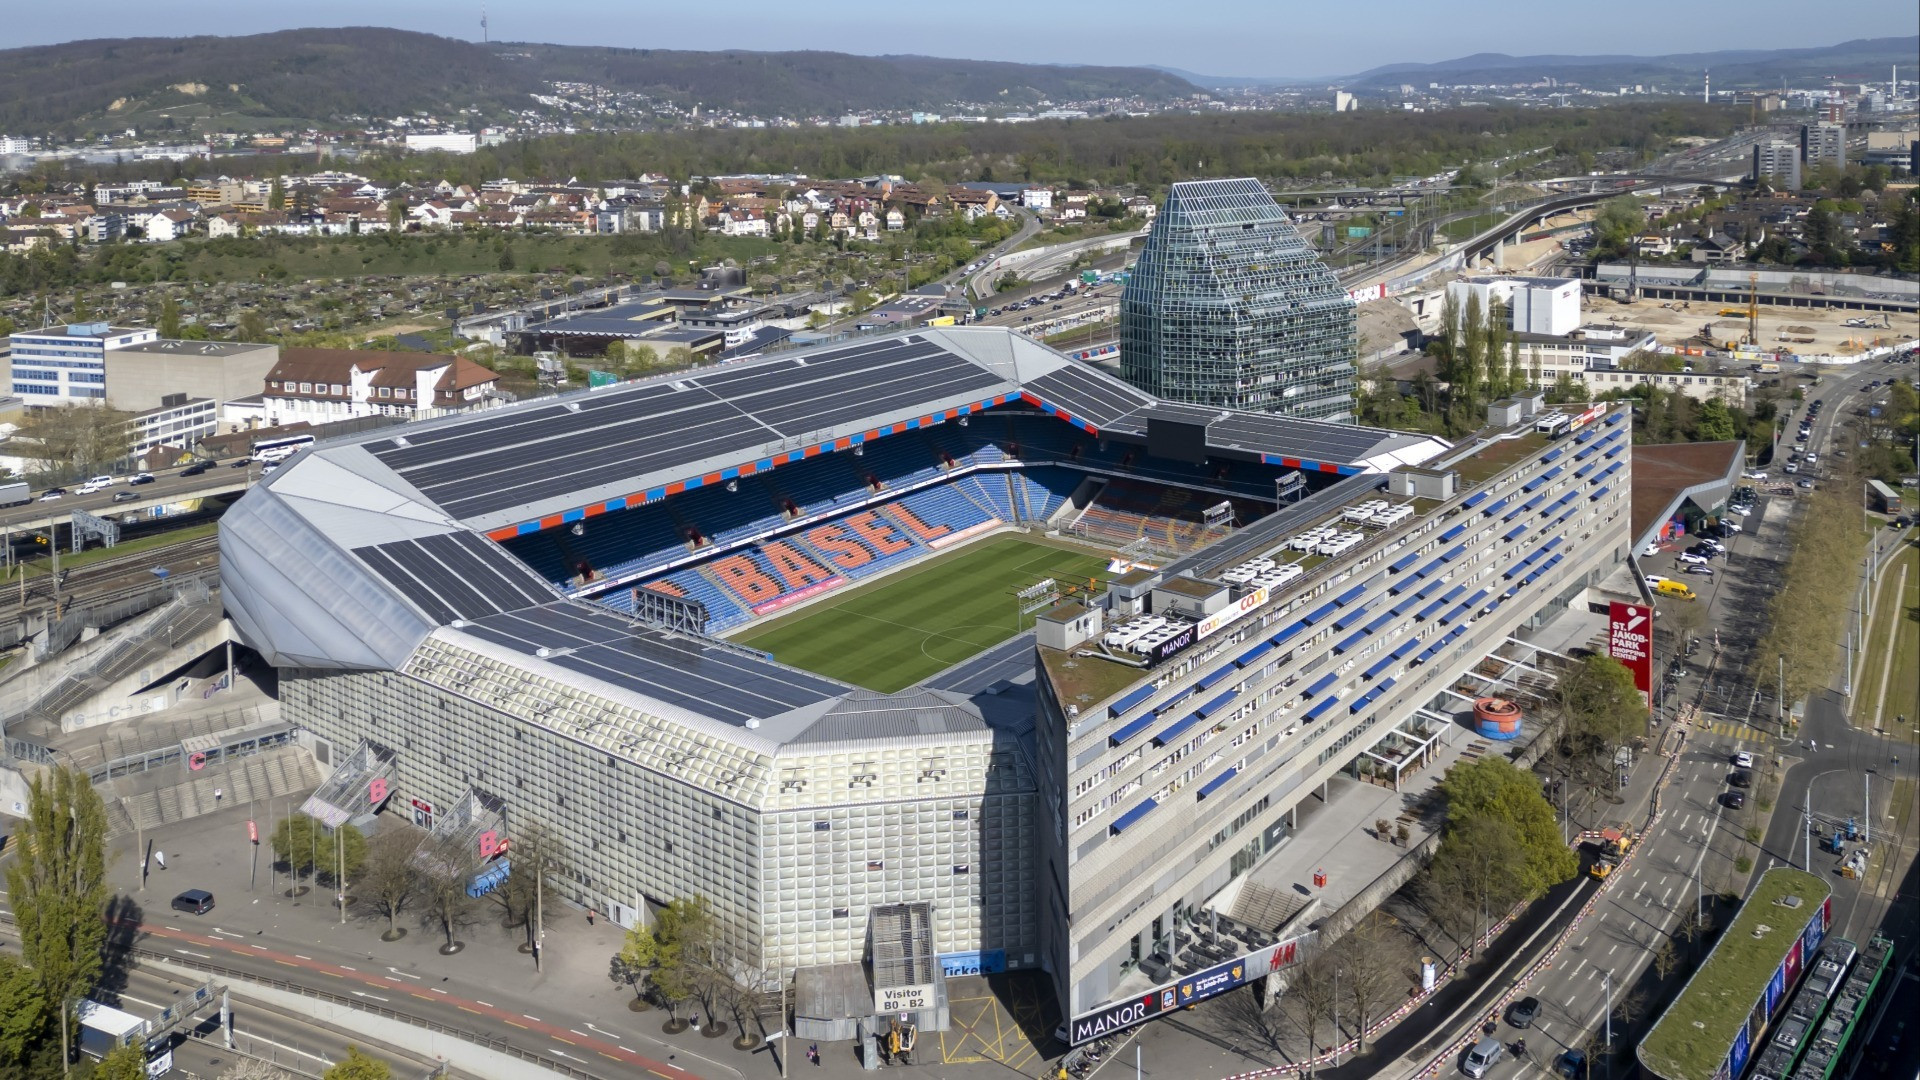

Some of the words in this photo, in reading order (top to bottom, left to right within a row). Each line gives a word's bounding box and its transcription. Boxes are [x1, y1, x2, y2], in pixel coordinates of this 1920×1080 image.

[709, 502, 953, 604] BASEL
[1240, 587, 1267, 611] coop
[1200, 617, 1220, 635] coop
[1612, 621, 1627, 631] ST.
[1612, 630, 1648, 643] JAKOB-
[1612, 638, 1639, 650] PARK
[1161, 632, 1191, 658] MANOR
[1612, 647, 1646, 657] SHOPPING
[1612, 652, 1637, 661] CENTER
[370, 778, 387, 804] B
[480, 830, 497, 857] B
[473, 876, 509, 898] Ticks
[943, 965, 992, 977] Tickets
[884, 989, 922, 999] Visitor
[884, 1001, 898, 1010] B0
[909, 999, 924, 1008] B2
[1077, 1002, 1145, 1041] MANOR
